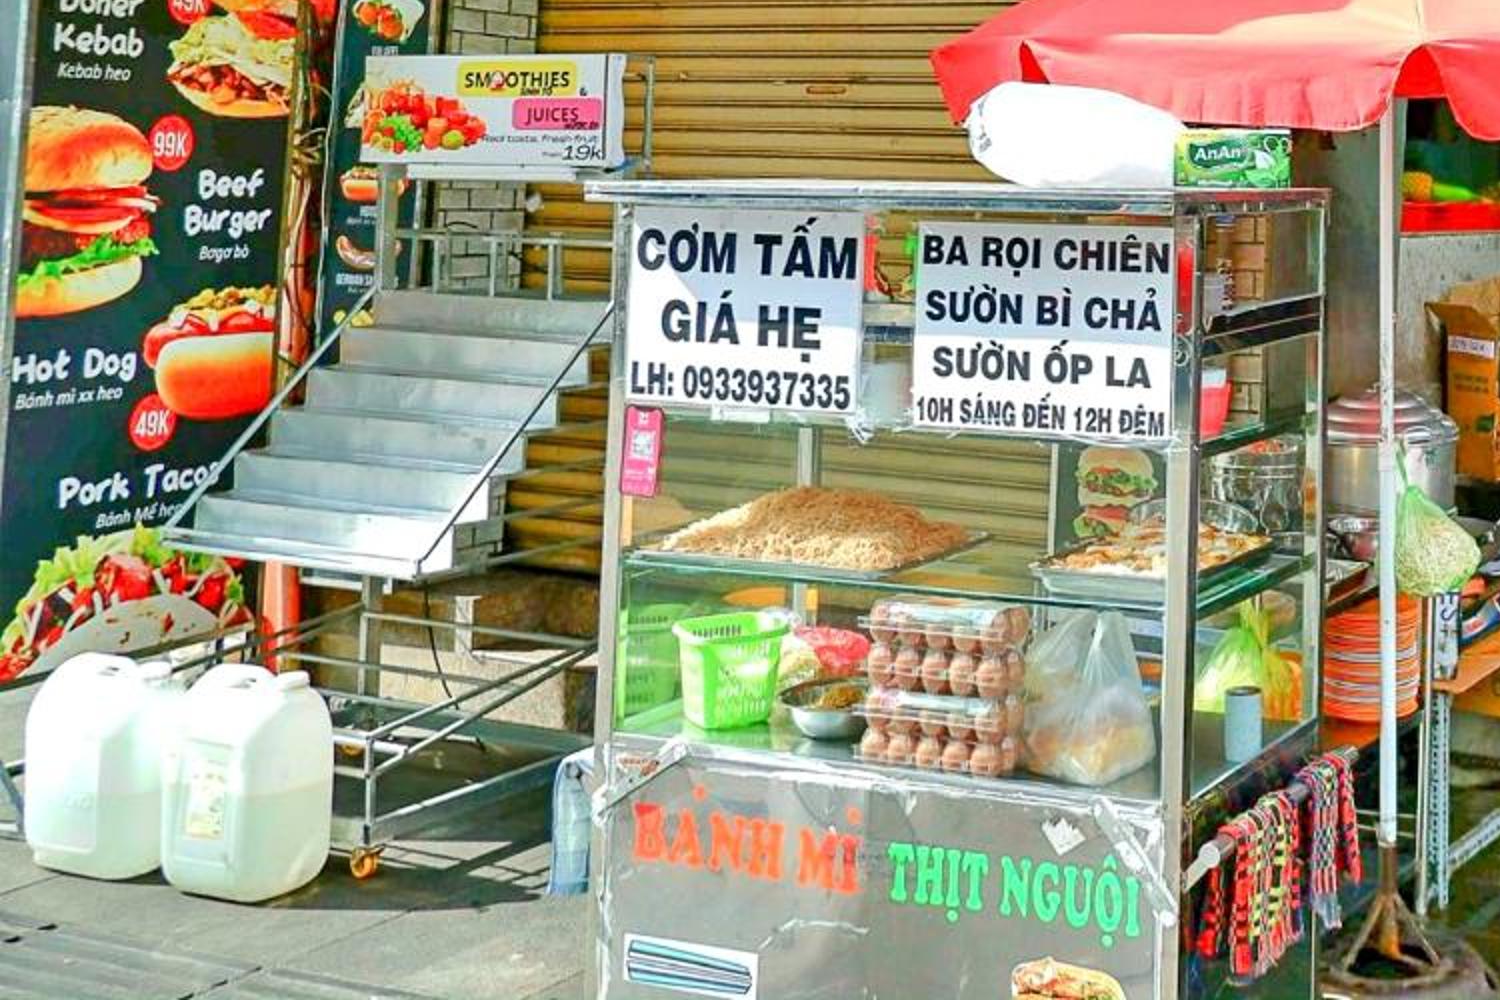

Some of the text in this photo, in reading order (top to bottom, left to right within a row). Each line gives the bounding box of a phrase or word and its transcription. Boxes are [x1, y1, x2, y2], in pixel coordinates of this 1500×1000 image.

[53, 23, 145, 58] Kebab
[58, 62, 132, 82] Kebab heo
[465, 70, 569, 89] SMOOTHIES
[525, 107, 579, 126] JUICES
[154, 134, 188, 158] 99K
[1194, 146, 1241, 161] AnAn
[199, 168, 264, 200] Beef
[185, 204, 272, 239] Burger
[637, 217, 857, 279] CƠM TẤM
[923, 234, 1169, 277] BA RỌI CHIÊN
[925, 284, 1161, 331] SƯỜN BÌ CHẢ
[661, 290, 821, 363] GIÁ HẸ
[11, 348, 137, 384] Hot Dog
[933, 339, 1151, 388] SƯỜN ỐP LA
[97, 385, 123, 401] heo
[631, 361, 850, 410] LH: 0933937335
[135, 409, 171, 437] 49K
[917, 393, 1164, 436] 10H SÁNG ĐẾN 12H ĐÊM
[58, 461, 219, 509] Pork Tacos
[887, 842, 1141, 948] THỊT NGUỘI
